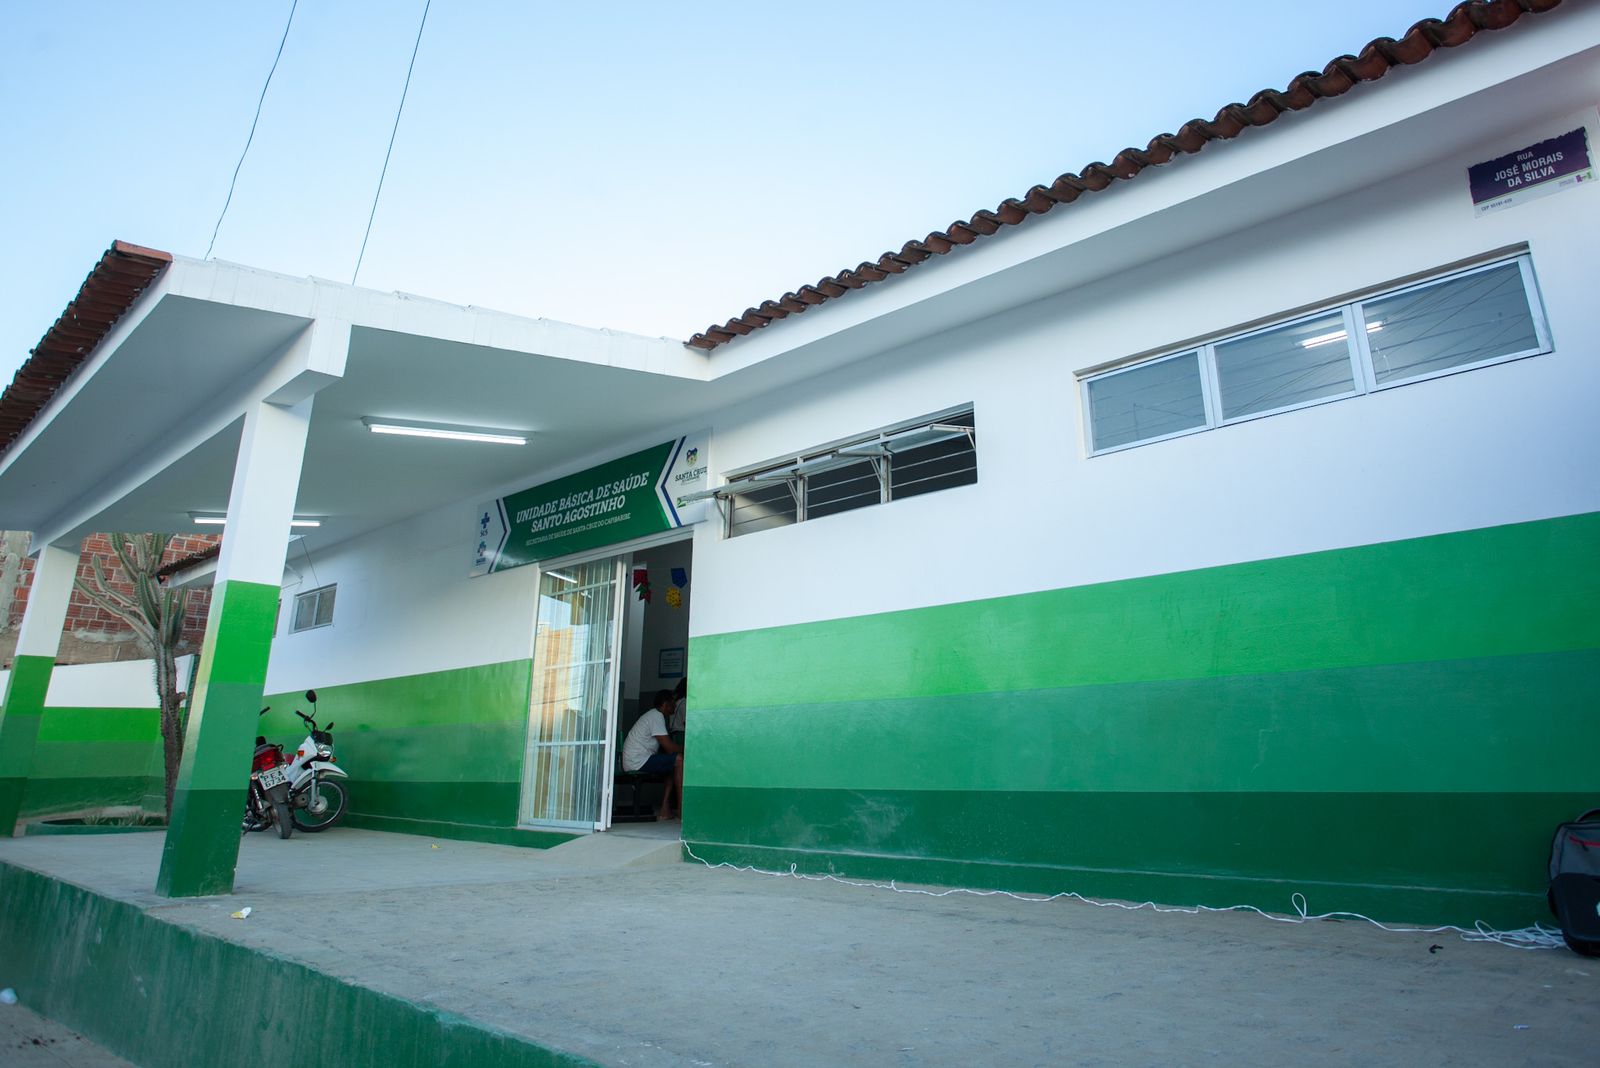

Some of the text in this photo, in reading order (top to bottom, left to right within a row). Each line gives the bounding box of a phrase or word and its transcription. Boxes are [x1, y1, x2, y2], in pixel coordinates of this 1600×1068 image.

[1494, 151, 1564, 182] JOSÉ MORAIS
[1517, 151, 1534, 162] RUA
[1507, 165, 1555, 188] DA SILVA
[675, 470, 693, 482] SANTA
[693, 466, 708, 477] CRUZ
[516, 471, 650, 523] UNIDADE BÁSICA DE SAÚDE
[531, 495, 626, 533] SANTO AGOSTINHO
[597, 519, 605, 527] DO
